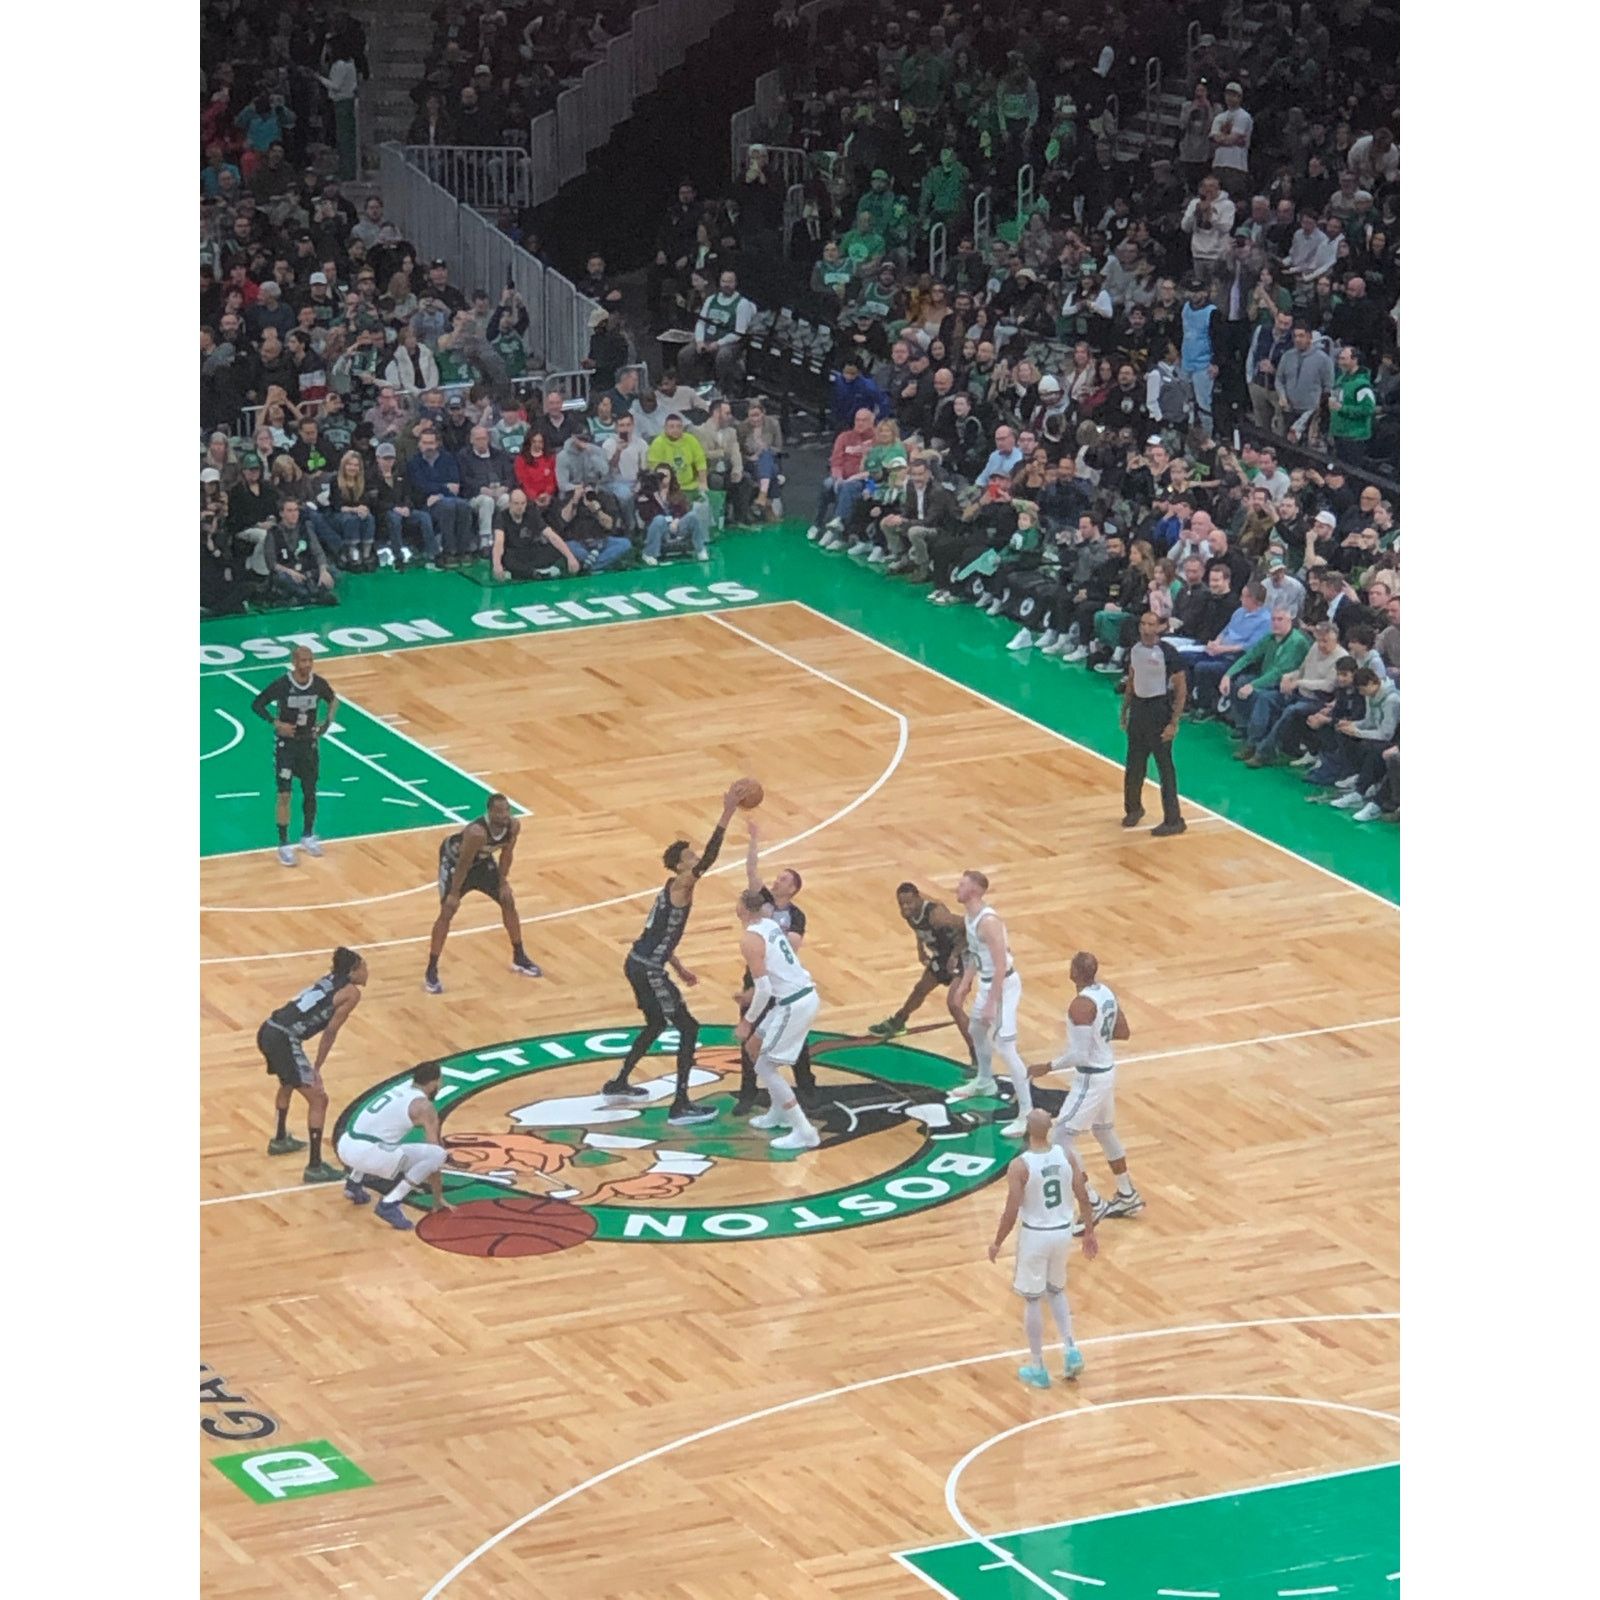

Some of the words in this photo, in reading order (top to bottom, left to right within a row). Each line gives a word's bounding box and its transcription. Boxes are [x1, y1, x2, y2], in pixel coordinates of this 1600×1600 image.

[471, 582, 759, 629] CELTICS
[779, 939, 794, 965] 8
[367, 1094, 393, 1114] 0
[623, 1152, 996, 1237] BOSTON
[1043, 1179, 1063, 1210] 9
[241, 1451, 339, 1498] TD
